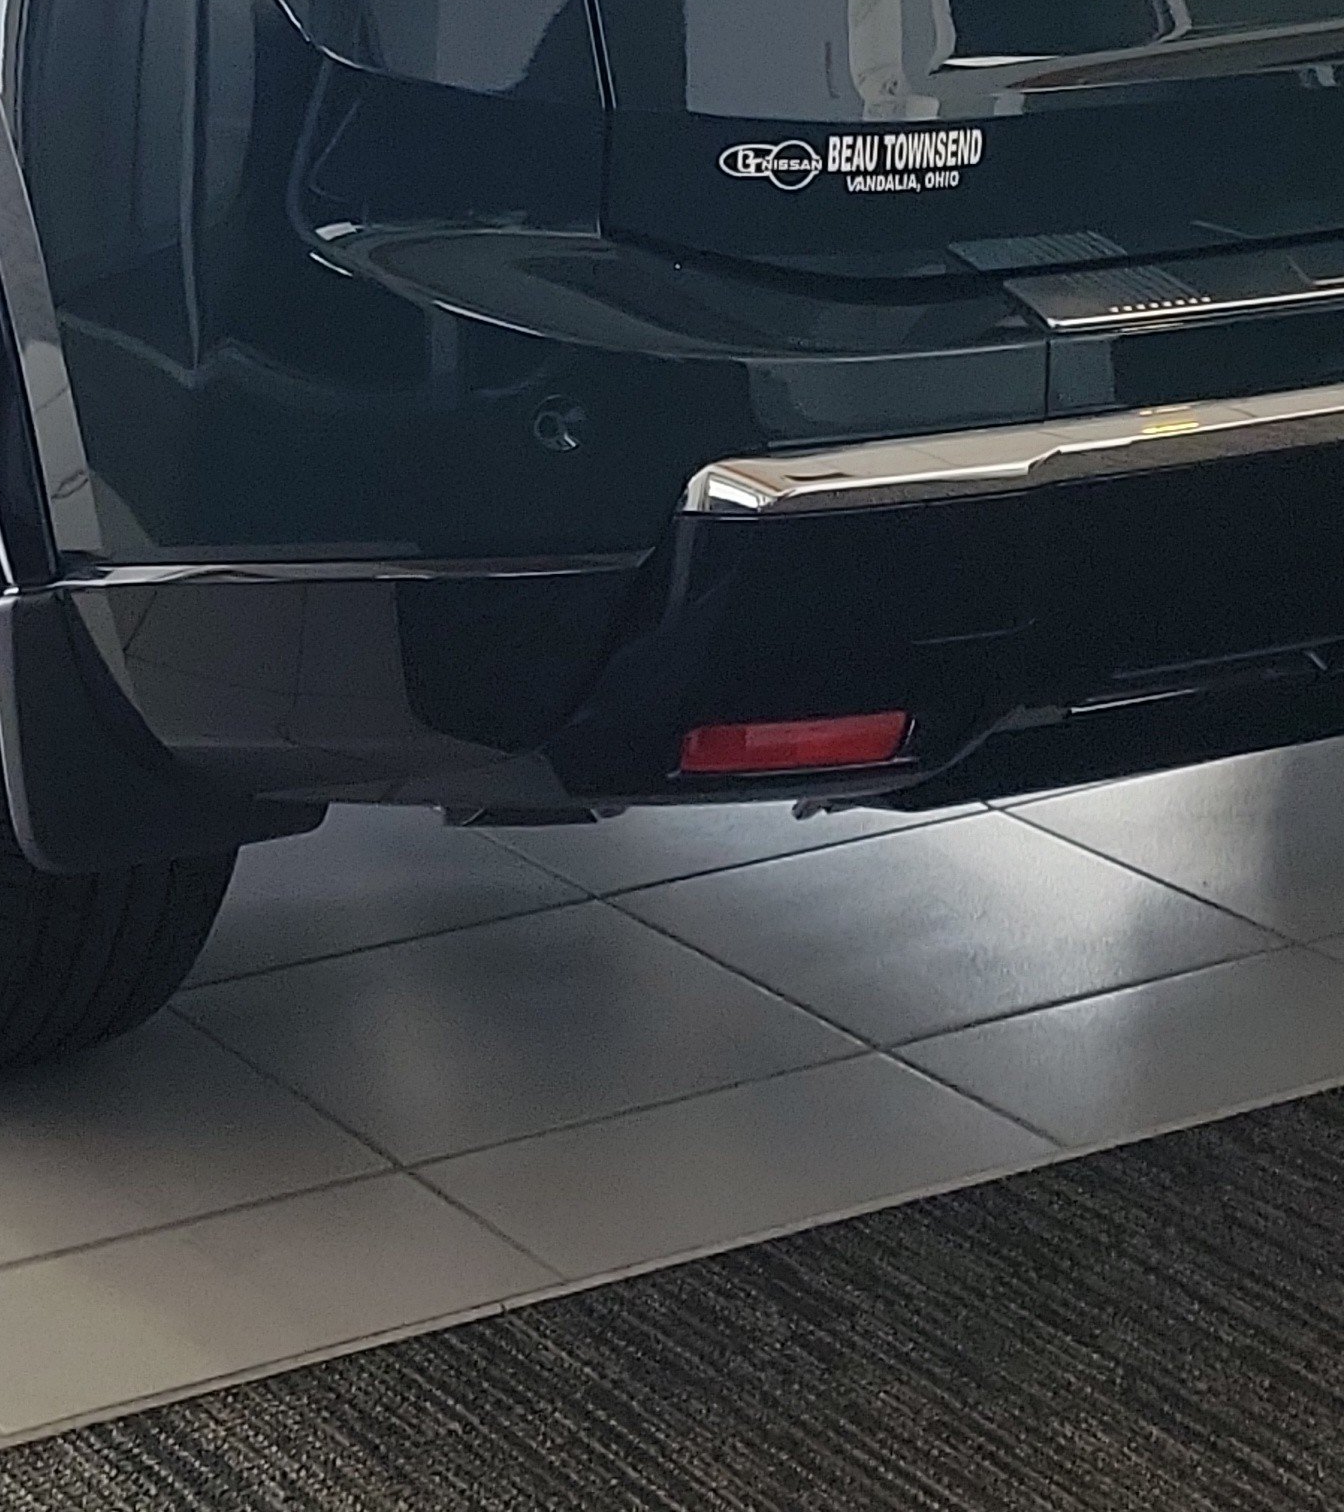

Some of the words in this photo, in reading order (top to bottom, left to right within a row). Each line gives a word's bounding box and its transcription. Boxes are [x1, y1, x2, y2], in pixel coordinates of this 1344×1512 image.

[827, 135, 879, 172] BEAU
[884, 128, 983, 170] TOWNSEND
[761, 158, 822, 172] NISSAN
[846, 173, 922, 192] VANDALIA,
[925, 171, 960, 189] OHIO
